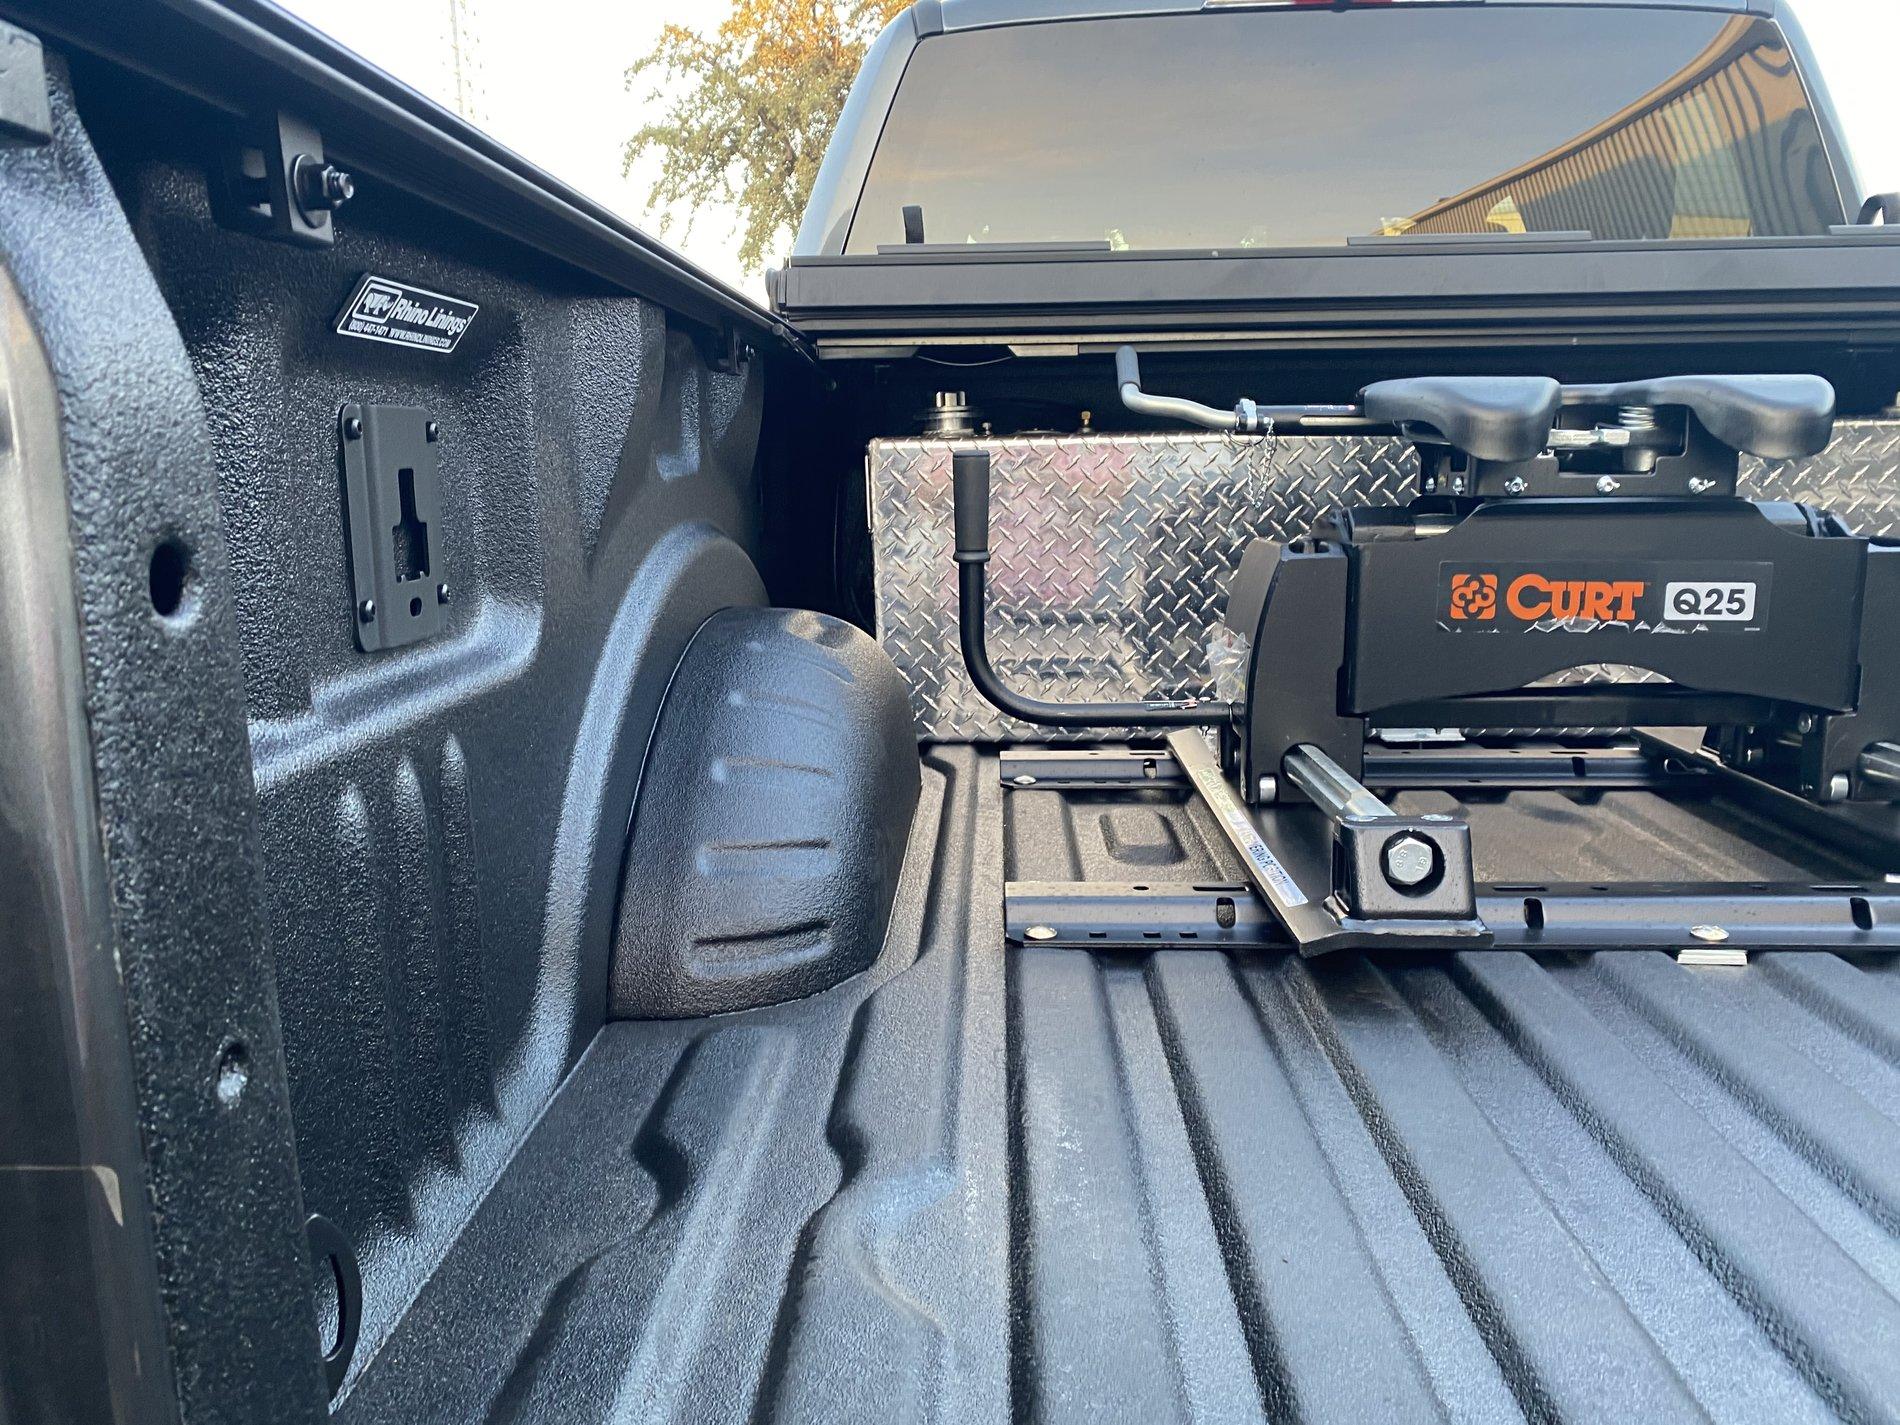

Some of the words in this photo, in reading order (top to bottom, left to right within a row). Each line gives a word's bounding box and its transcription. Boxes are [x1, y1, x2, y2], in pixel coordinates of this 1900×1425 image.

[390, 298, 429, 325] Rhino
[1506, 573, 1644, 621] CURT
[1673, 588, 1747, 616] Q25
